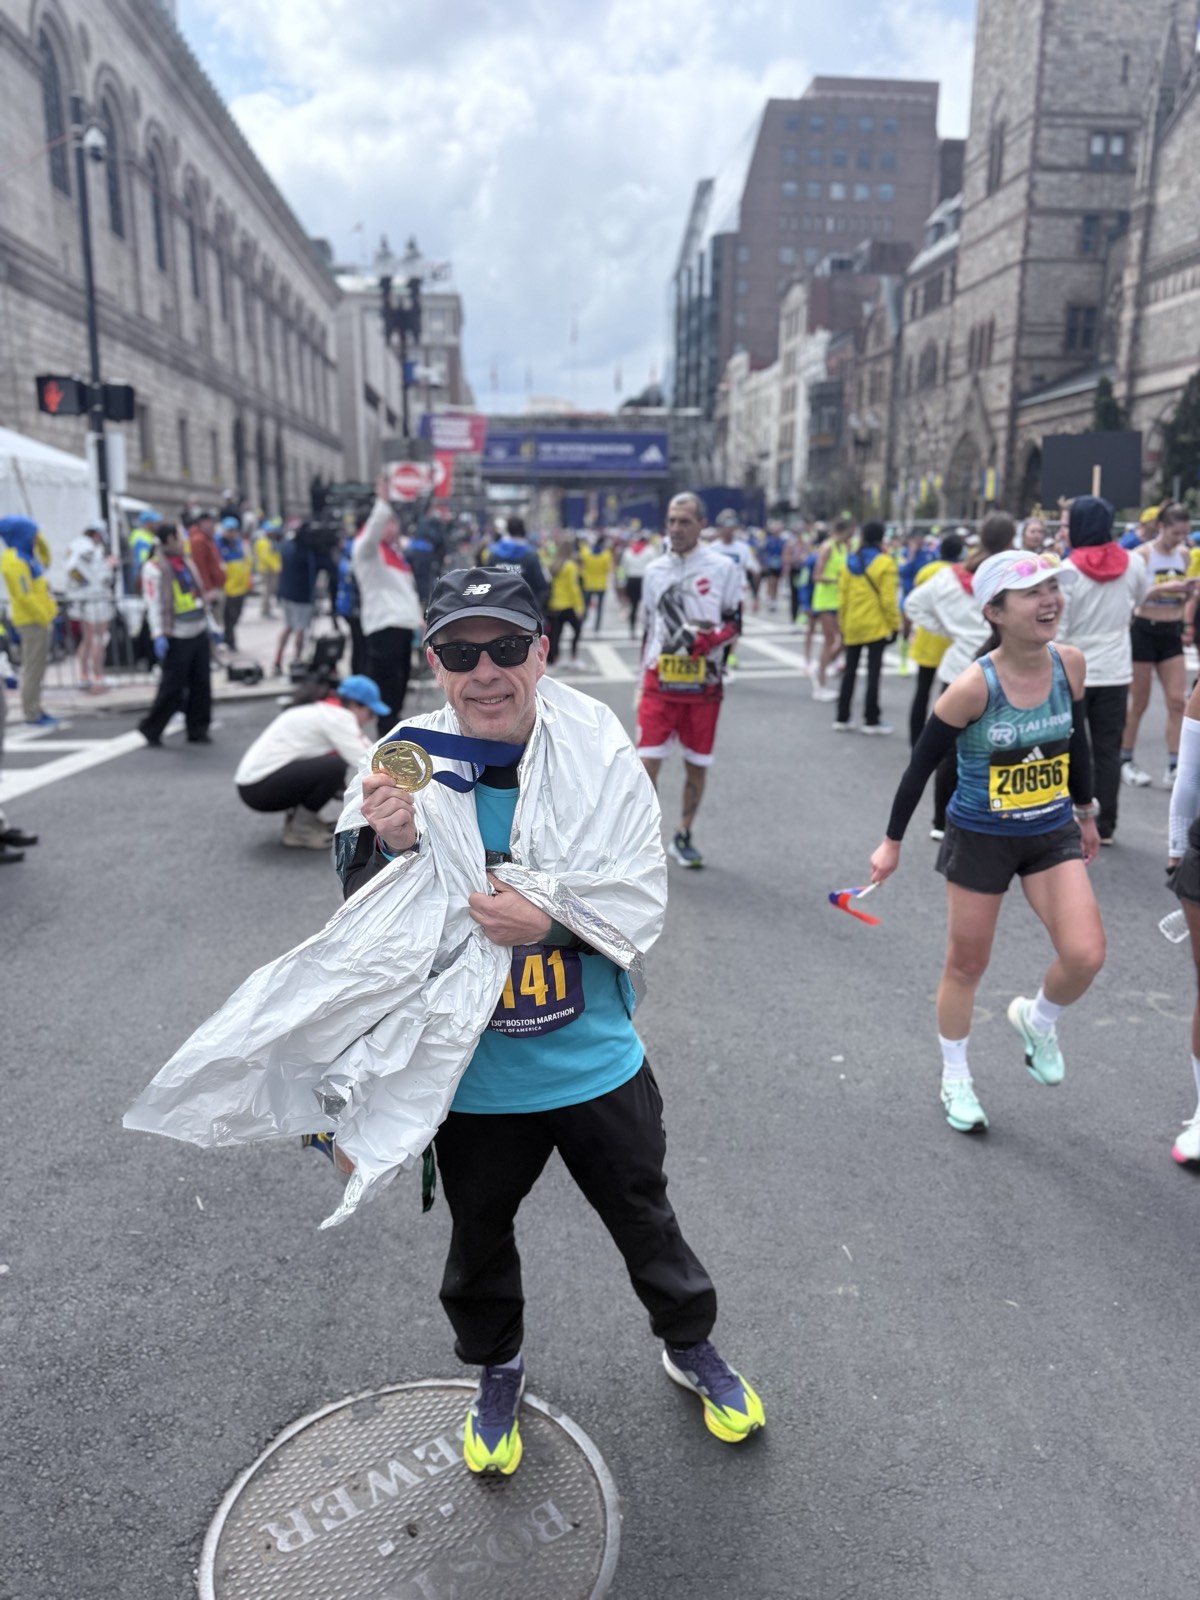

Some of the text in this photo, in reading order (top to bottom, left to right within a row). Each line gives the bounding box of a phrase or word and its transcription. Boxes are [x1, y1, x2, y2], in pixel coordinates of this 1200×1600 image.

[462, 583, 491, 596] NB
[996, 760, 1063, 795] 20956
[506, 1018, 535, 1027] BOSTON
[536, 1007, 575, 1025] MARATHON
[263, 1424, 466, 1553] EWER
